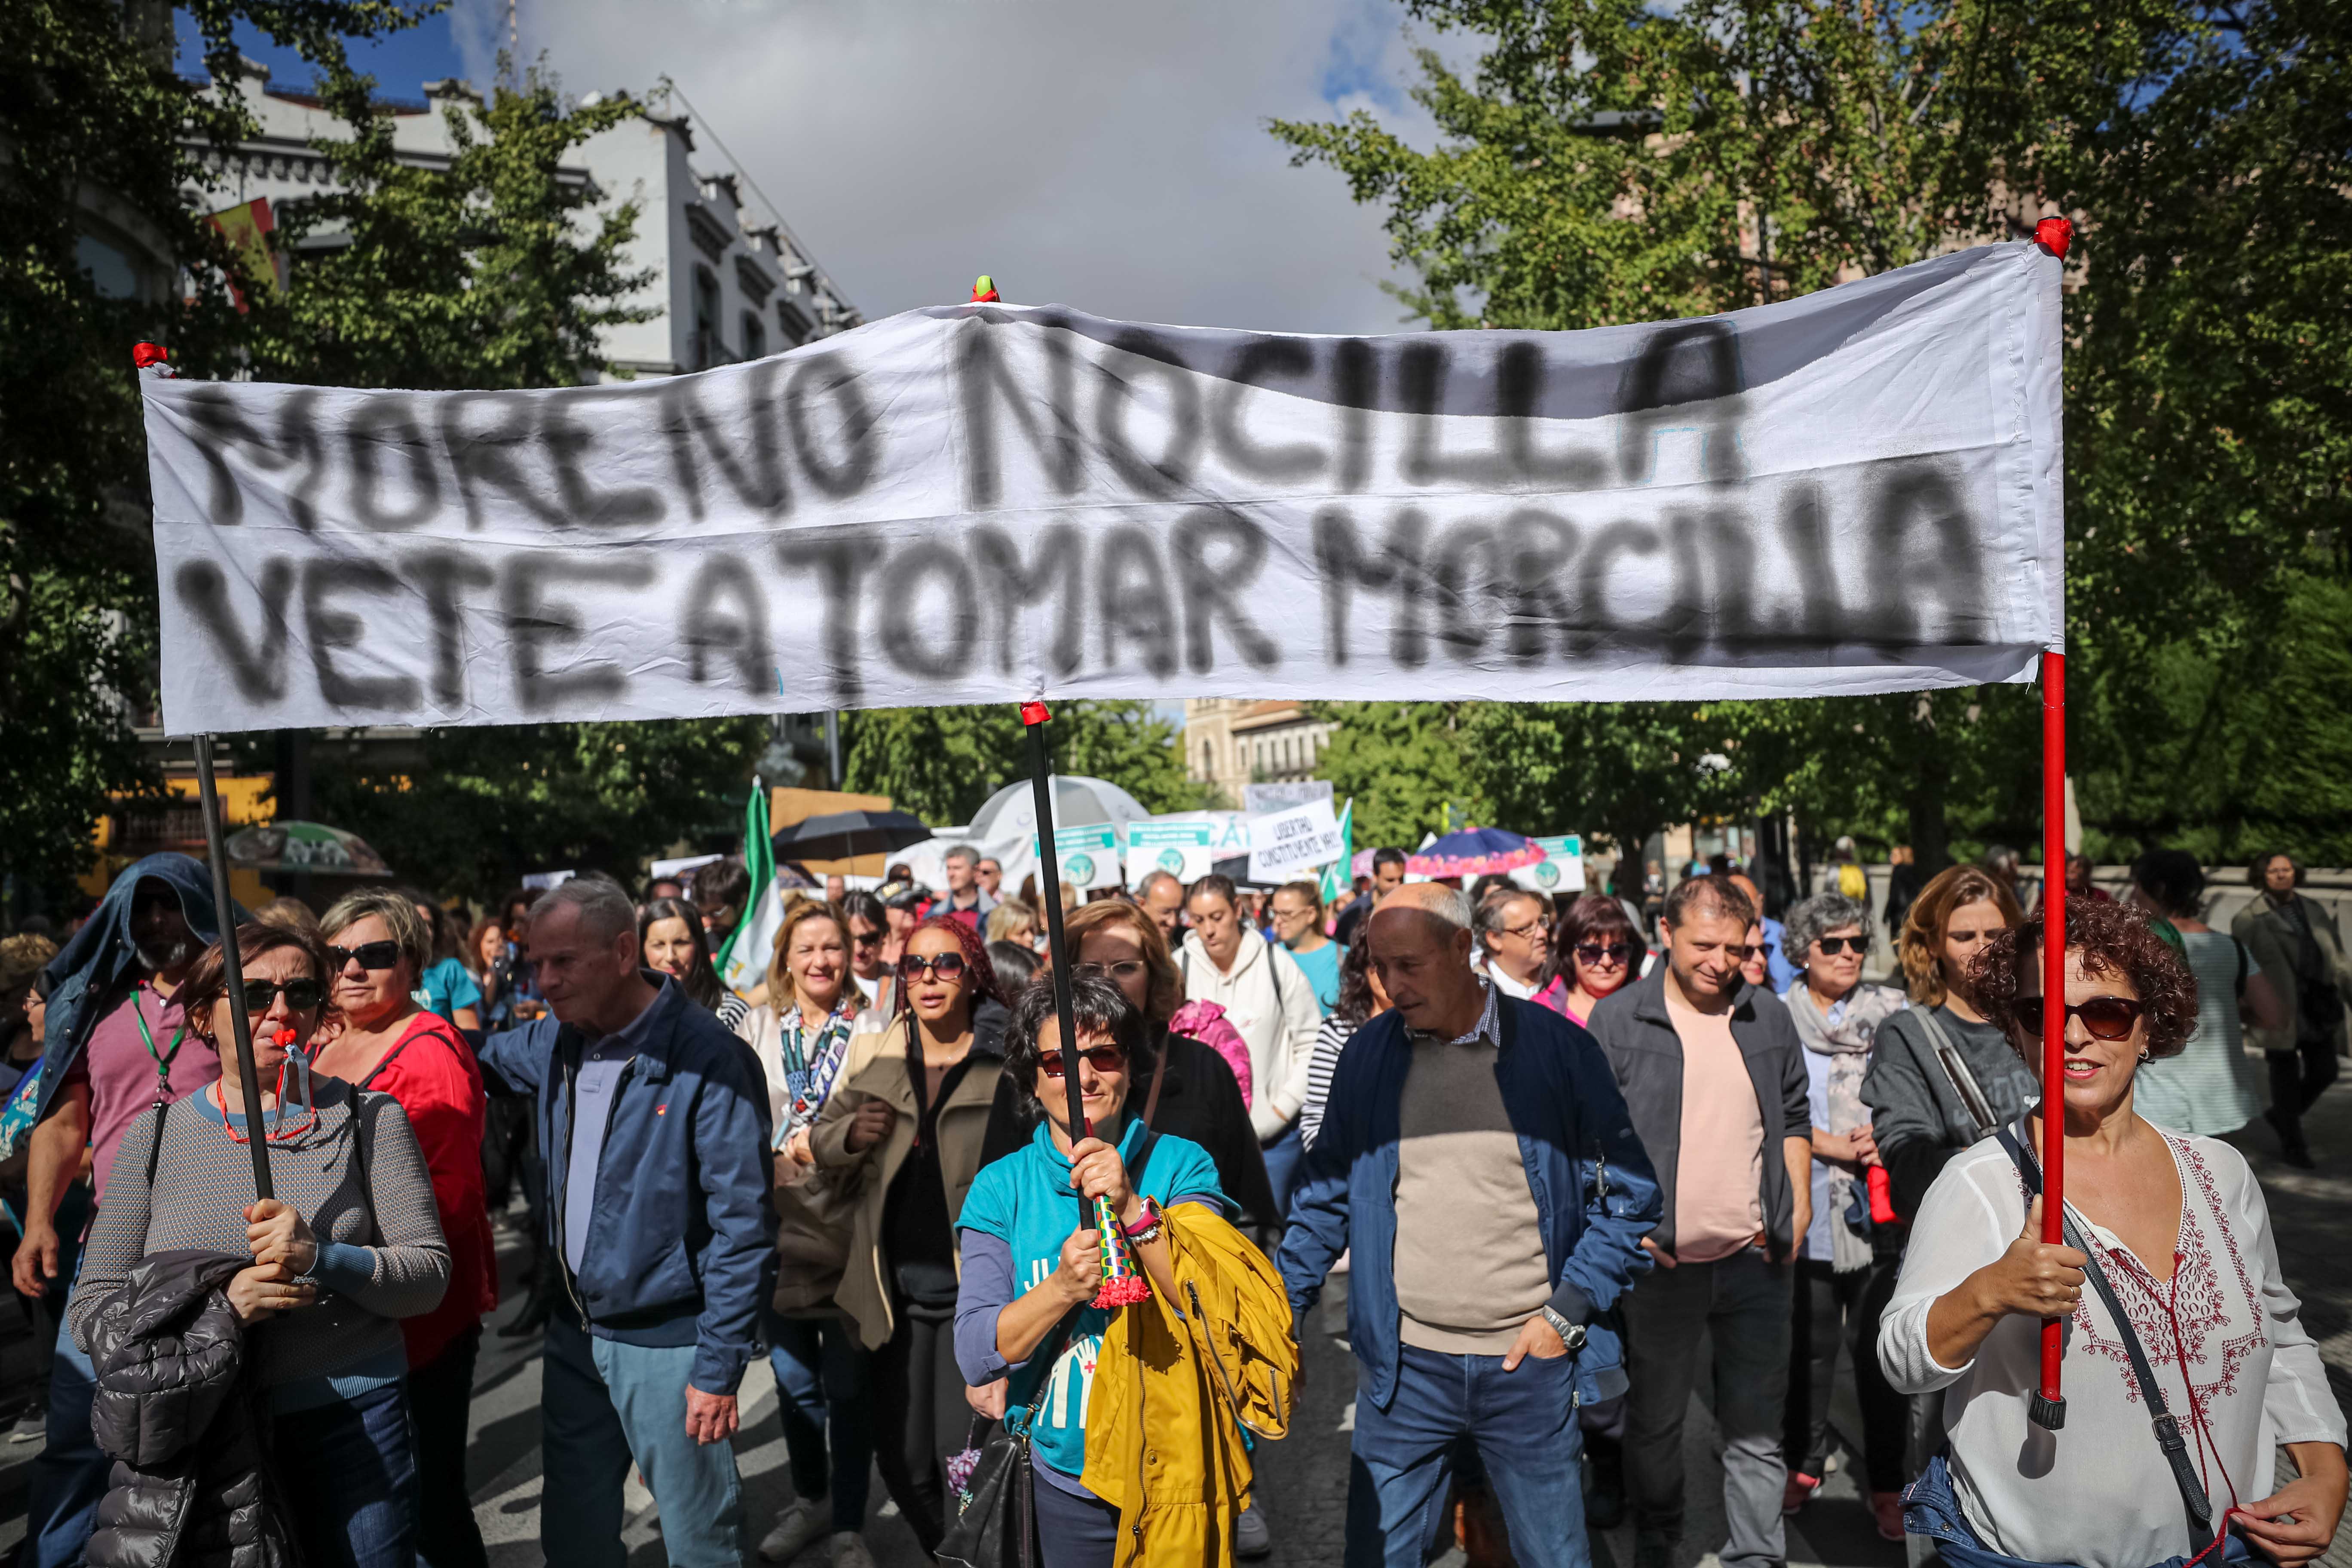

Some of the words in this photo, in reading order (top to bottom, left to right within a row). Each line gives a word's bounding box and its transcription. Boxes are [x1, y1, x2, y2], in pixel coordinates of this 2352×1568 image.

[181, 352, 880, 532] MORENO
[959, 309, 1756, 509] NOCILLA
[174, 545, 660, 714] VETE
[1311, 451, 1999, 673] MORCILLA
